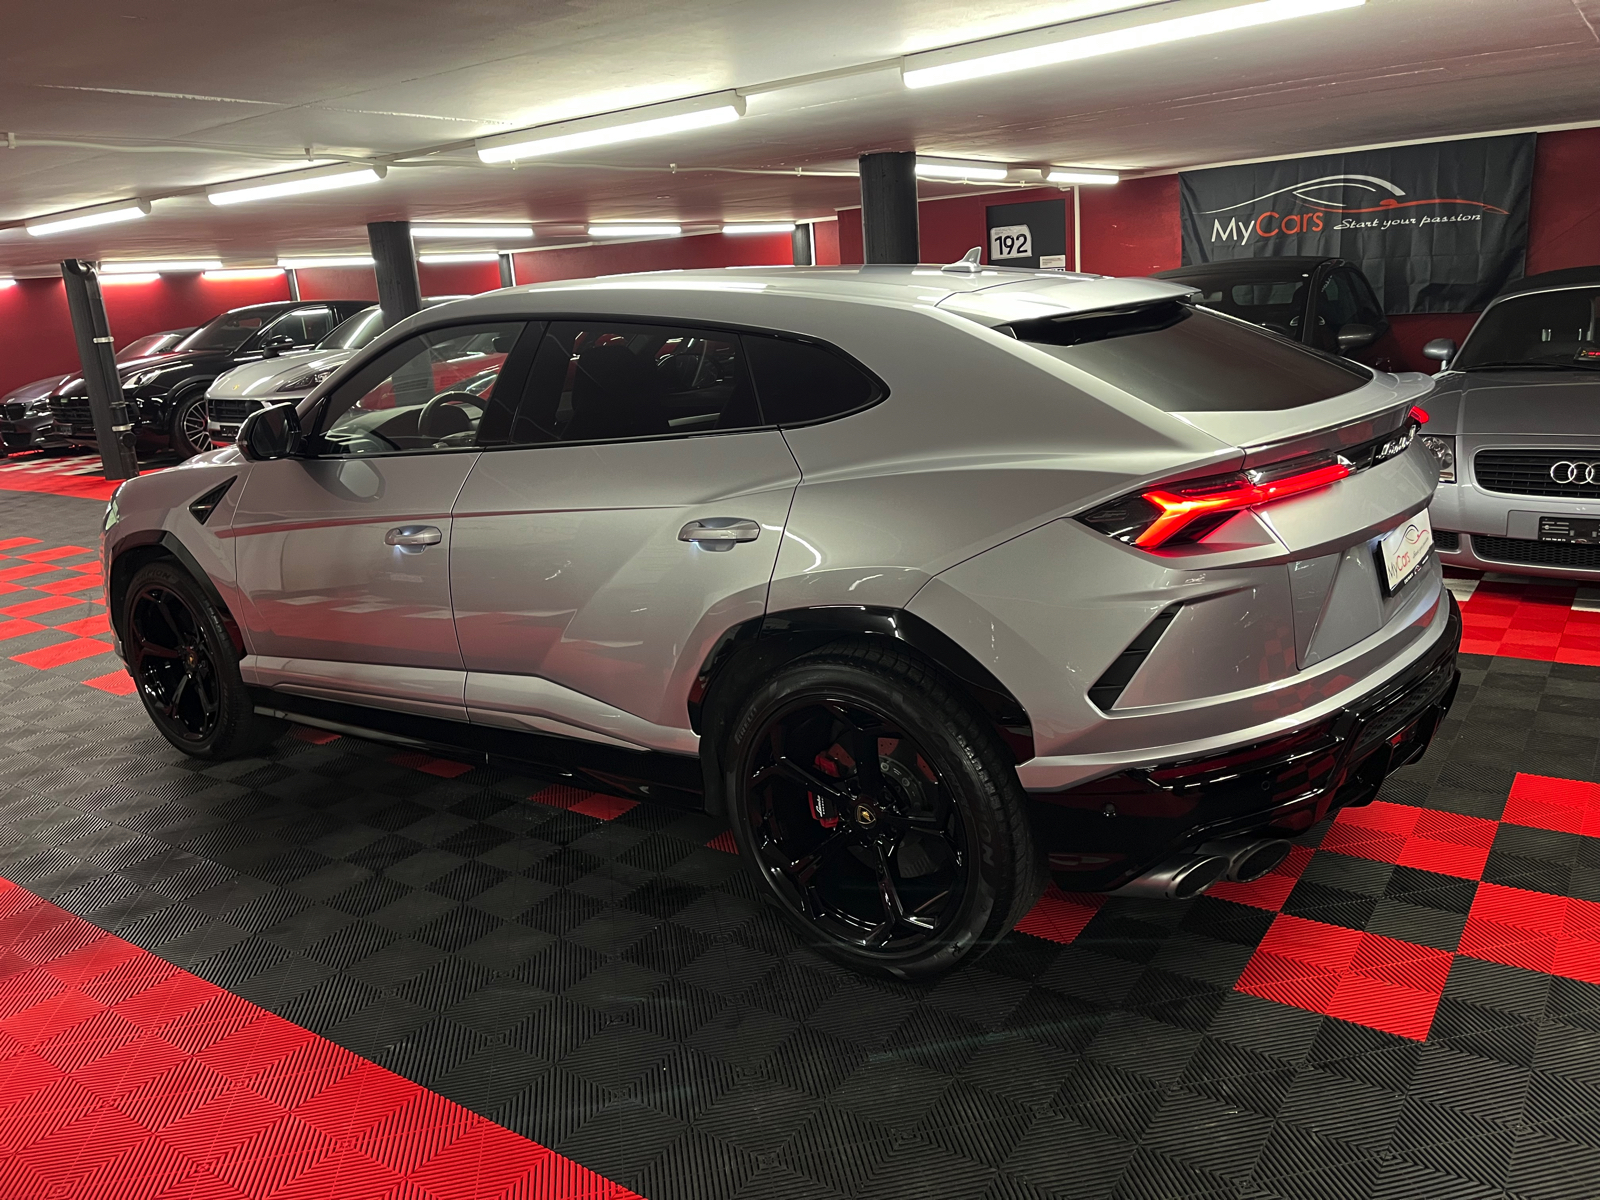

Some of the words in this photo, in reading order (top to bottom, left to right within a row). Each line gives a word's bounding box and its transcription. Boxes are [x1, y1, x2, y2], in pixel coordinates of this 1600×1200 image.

[1211, 211, 1324, 246] MyCars
[1333, 218, 1379, 230] Start
[1381, 216, 1417, 230] your
[1419, 213, 1481, 227] passion
[994, 233, 1028, 255] 192
